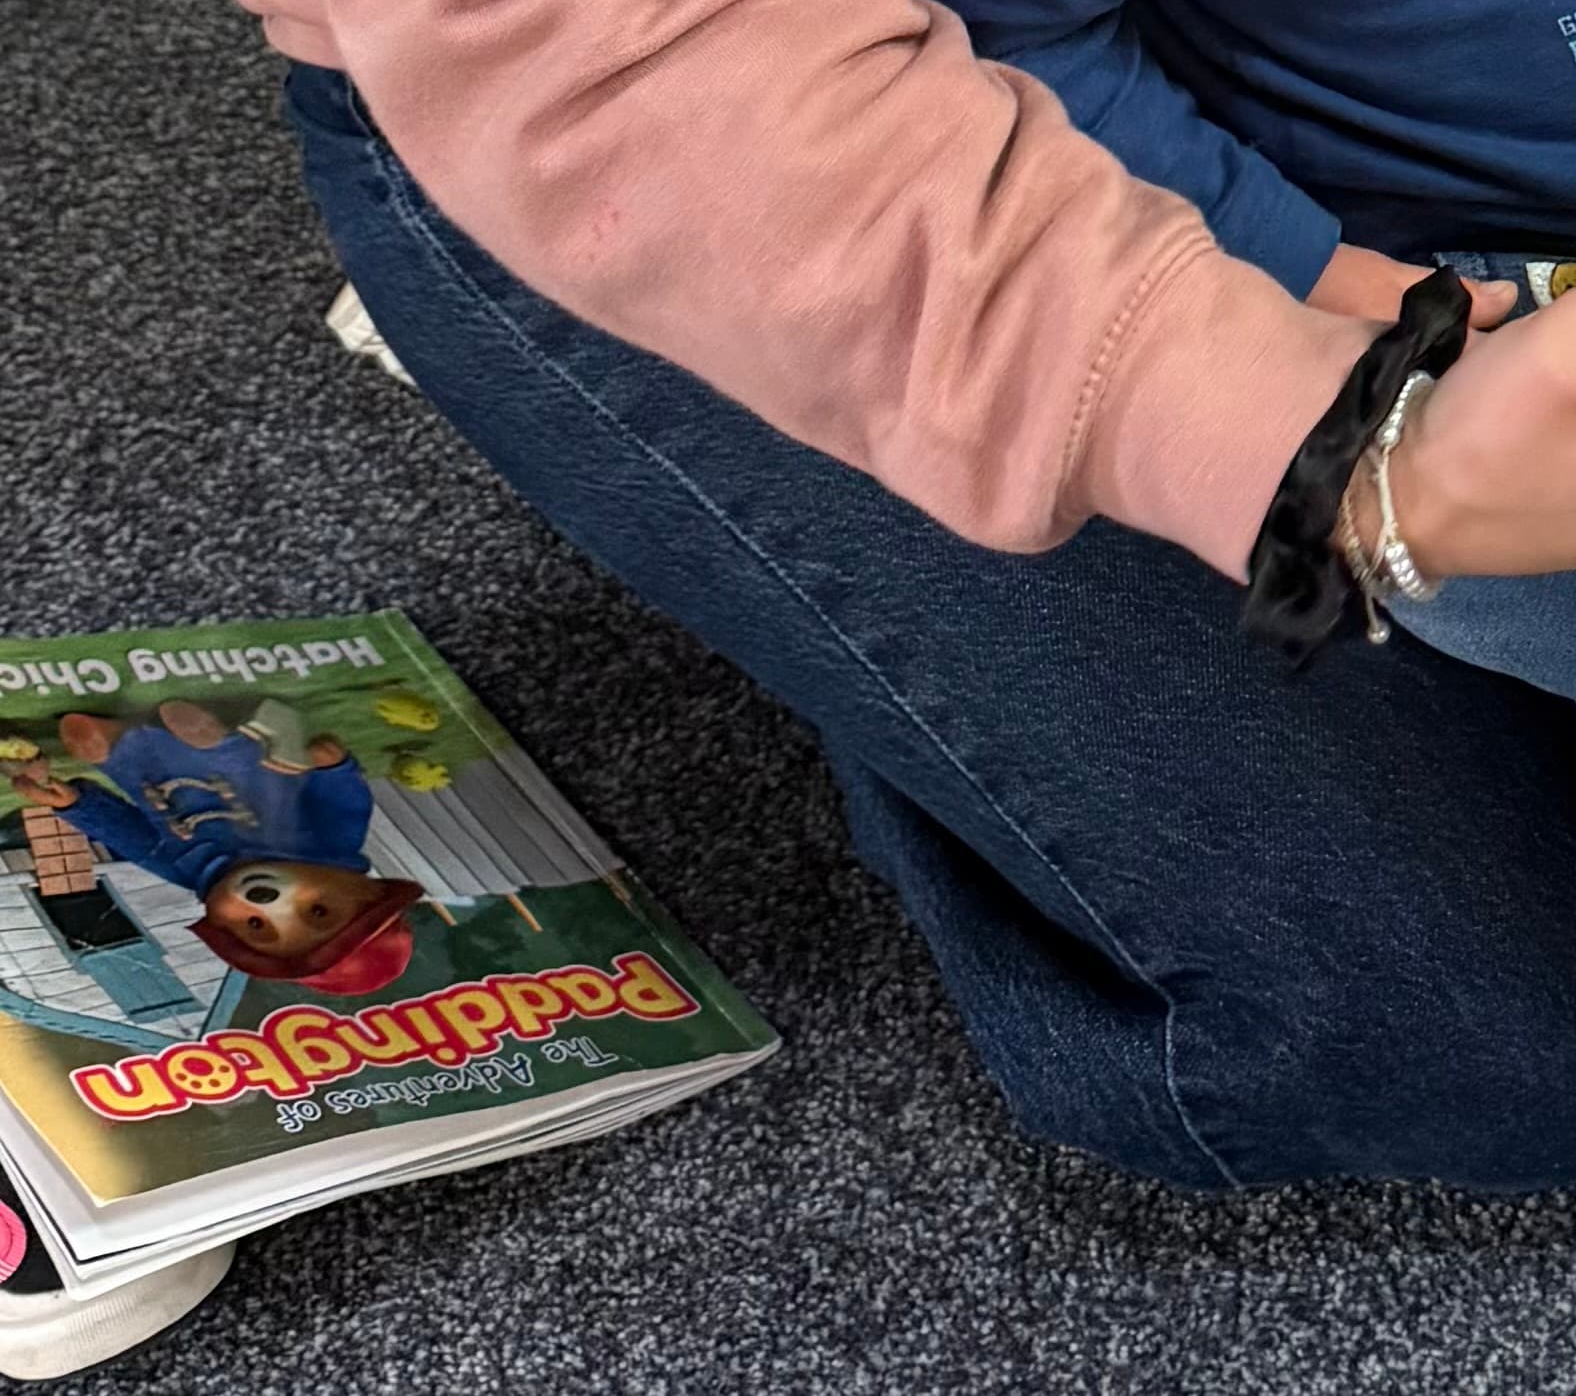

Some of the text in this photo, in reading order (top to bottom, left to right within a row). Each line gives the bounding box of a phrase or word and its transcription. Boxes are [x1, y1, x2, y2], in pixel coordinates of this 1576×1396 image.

[0, 636, 387, 695] Hatching Chic
[75, 953, 700, 1119] Paddington
[275, 1035, 619, 1134] The Adventures of
